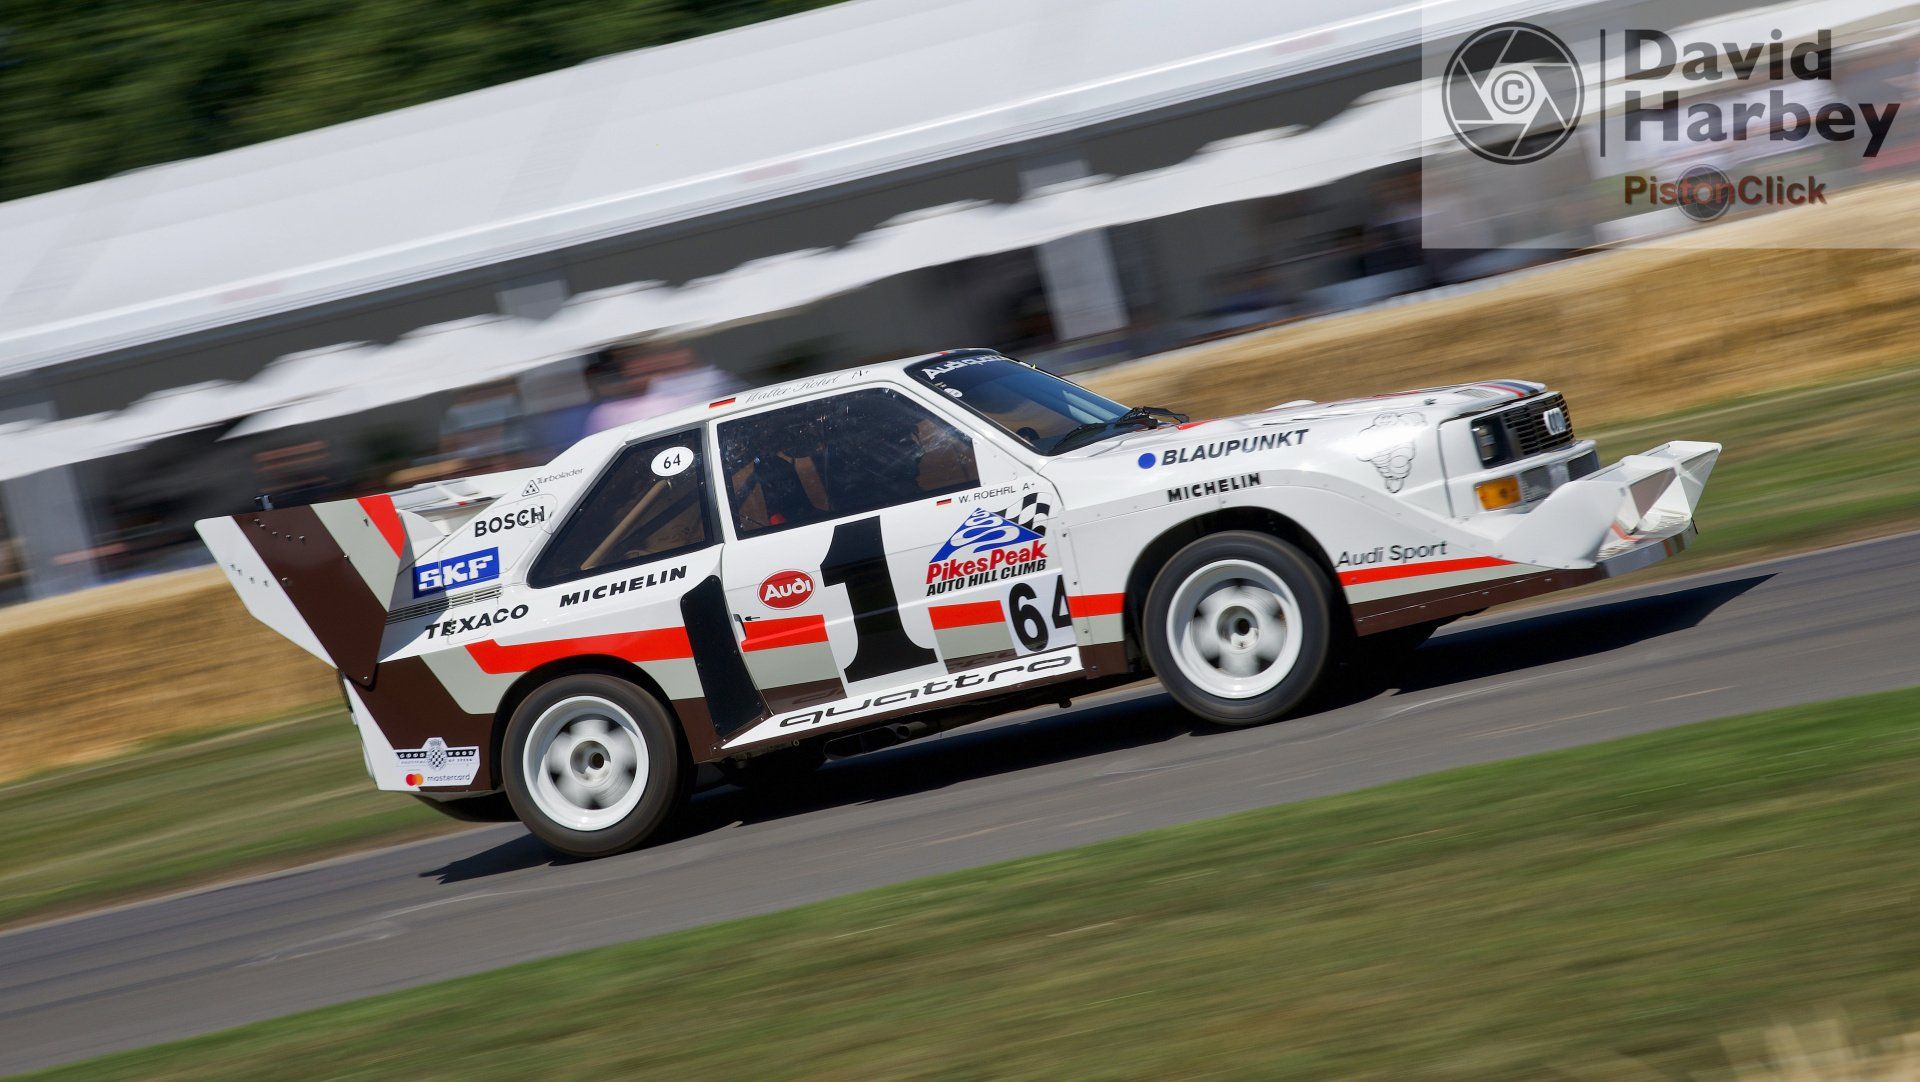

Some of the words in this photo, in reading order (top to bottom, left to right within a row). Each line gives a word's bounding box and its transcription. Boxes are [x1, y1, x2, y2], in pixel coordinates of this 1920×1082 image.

[663, 453, 681, 469] 64
[1161, 428, 1309, 466] BLAUPUNKT
[537, 467, 584, 485] Turbolader
[958, 493, 971, 504] W.
[973, 485, 1016, 500] ROEHRL
[1167, 472, 1262, 503] MICHELIN
[474, 505, 545, 538] BOSCH
[418, 554, 494, 592] SKF
[1336, 545, 1384, 569] Audi
[1388, 540, 1448, 566] Sport
[559, 565, 688, 608] MICHELIN
[763, 577, 813, 602] Audi
[926, 577, 965, 597] AUTO
[967, 569, 998, 587] HILL
[1000, 559, 1047, 581] CLIMB
[820, 515, 939, 684] 1
[1008, 574, 1073, 653] 64
[424, 603, 530, 640] TEXACO
[779, 654, 1073, 729] quattro
